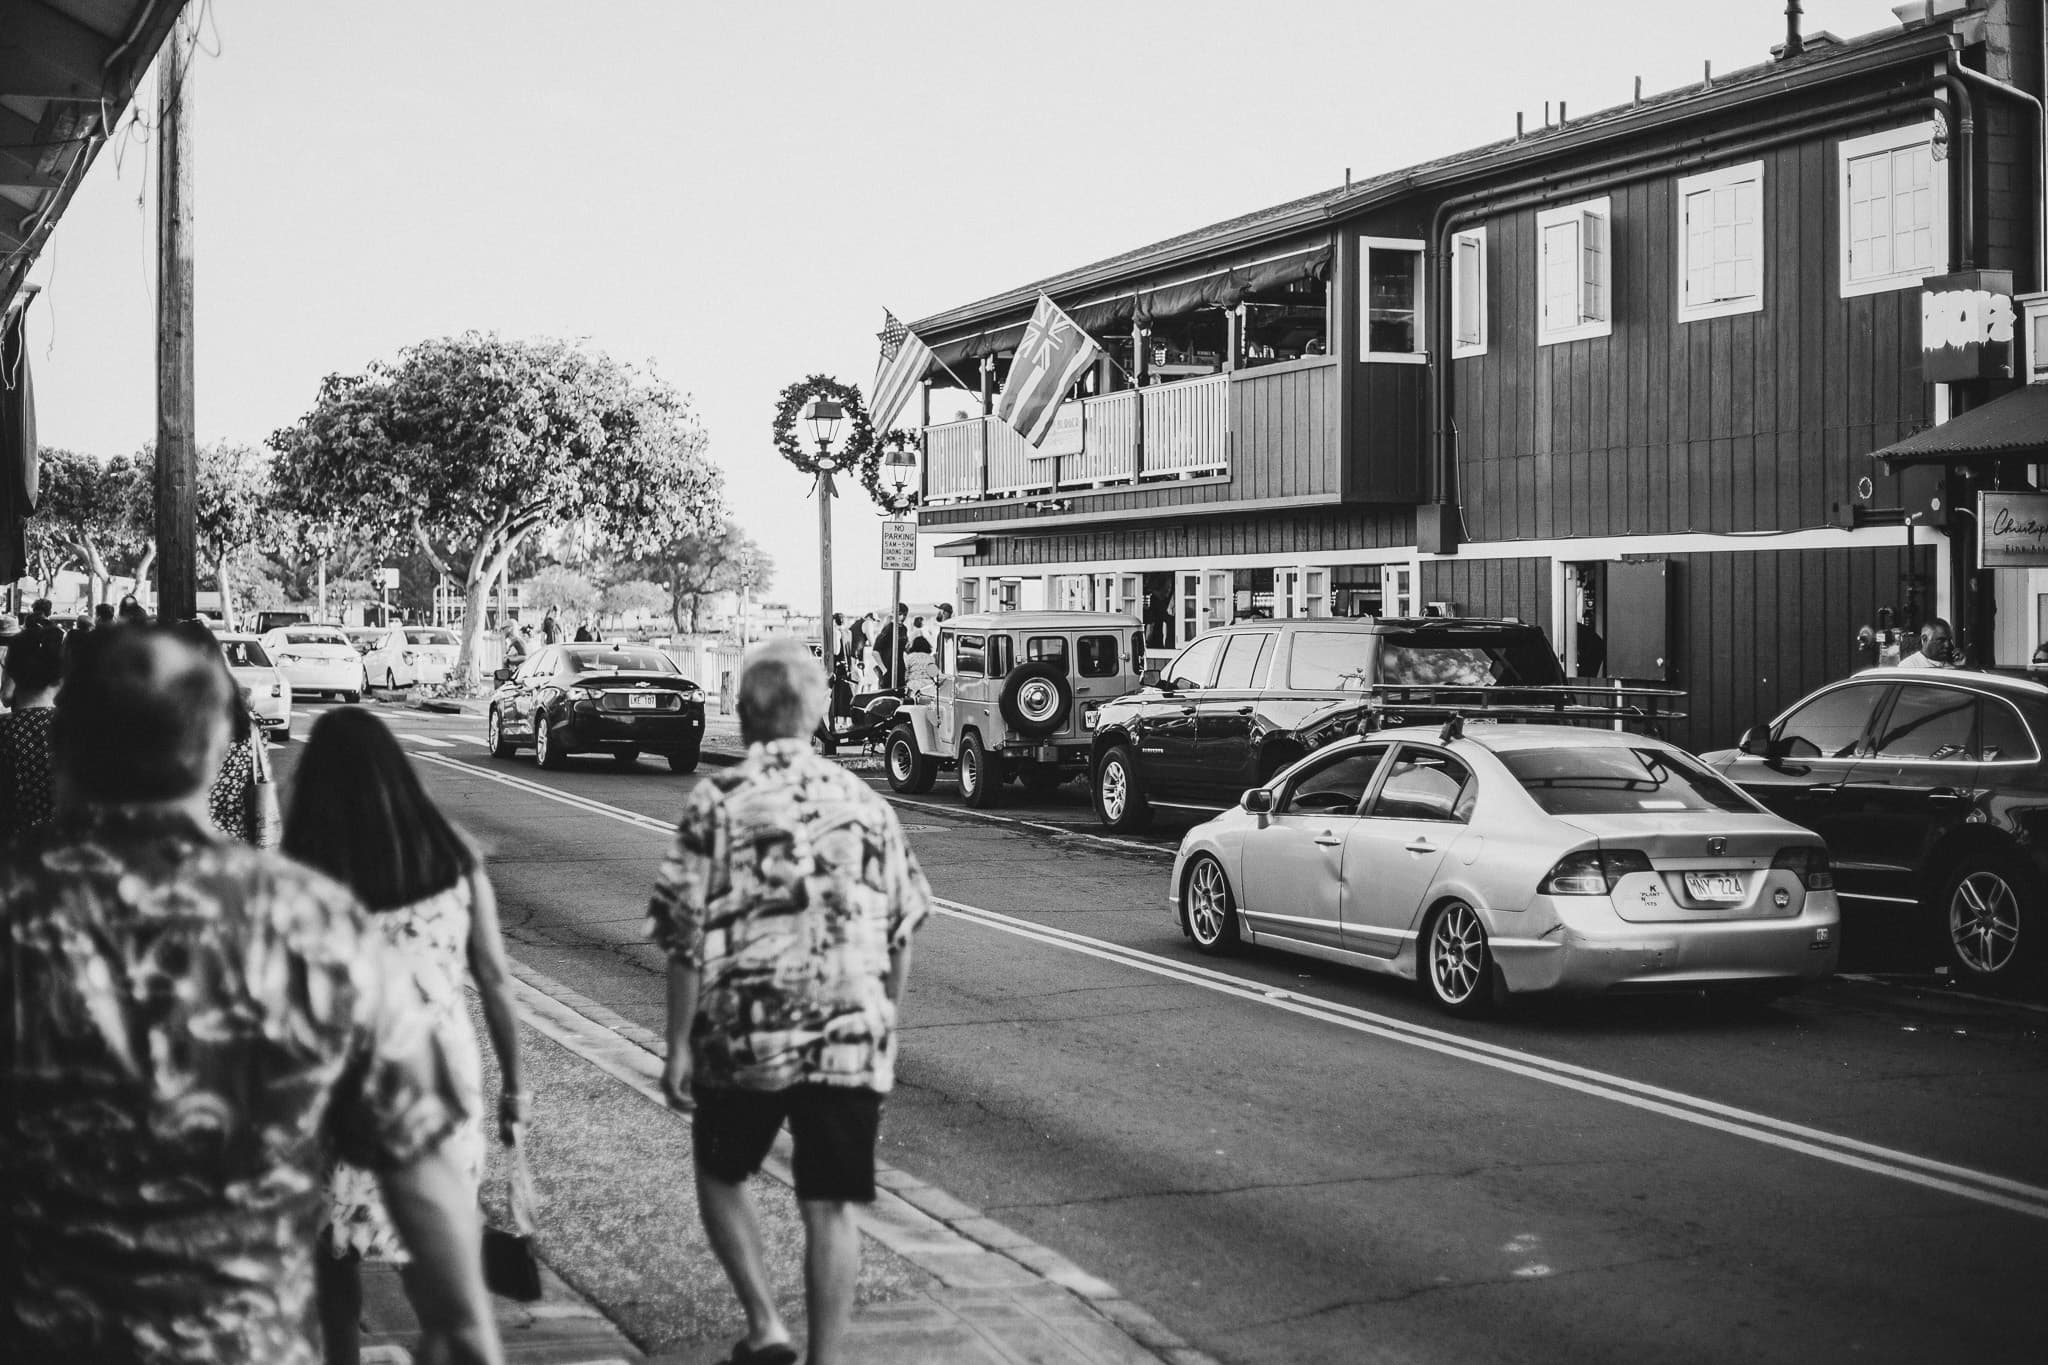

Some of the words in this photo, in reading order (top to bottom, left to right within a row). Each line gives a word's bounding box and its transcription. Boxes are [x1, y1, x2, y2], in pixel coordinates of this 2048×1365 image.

[885, 533, 914, 541] PARKING
[645, 695, 655, 704] 107
[1688, 879, 1712, 895] MNY
[1718, 879, 1743, 895] 224
